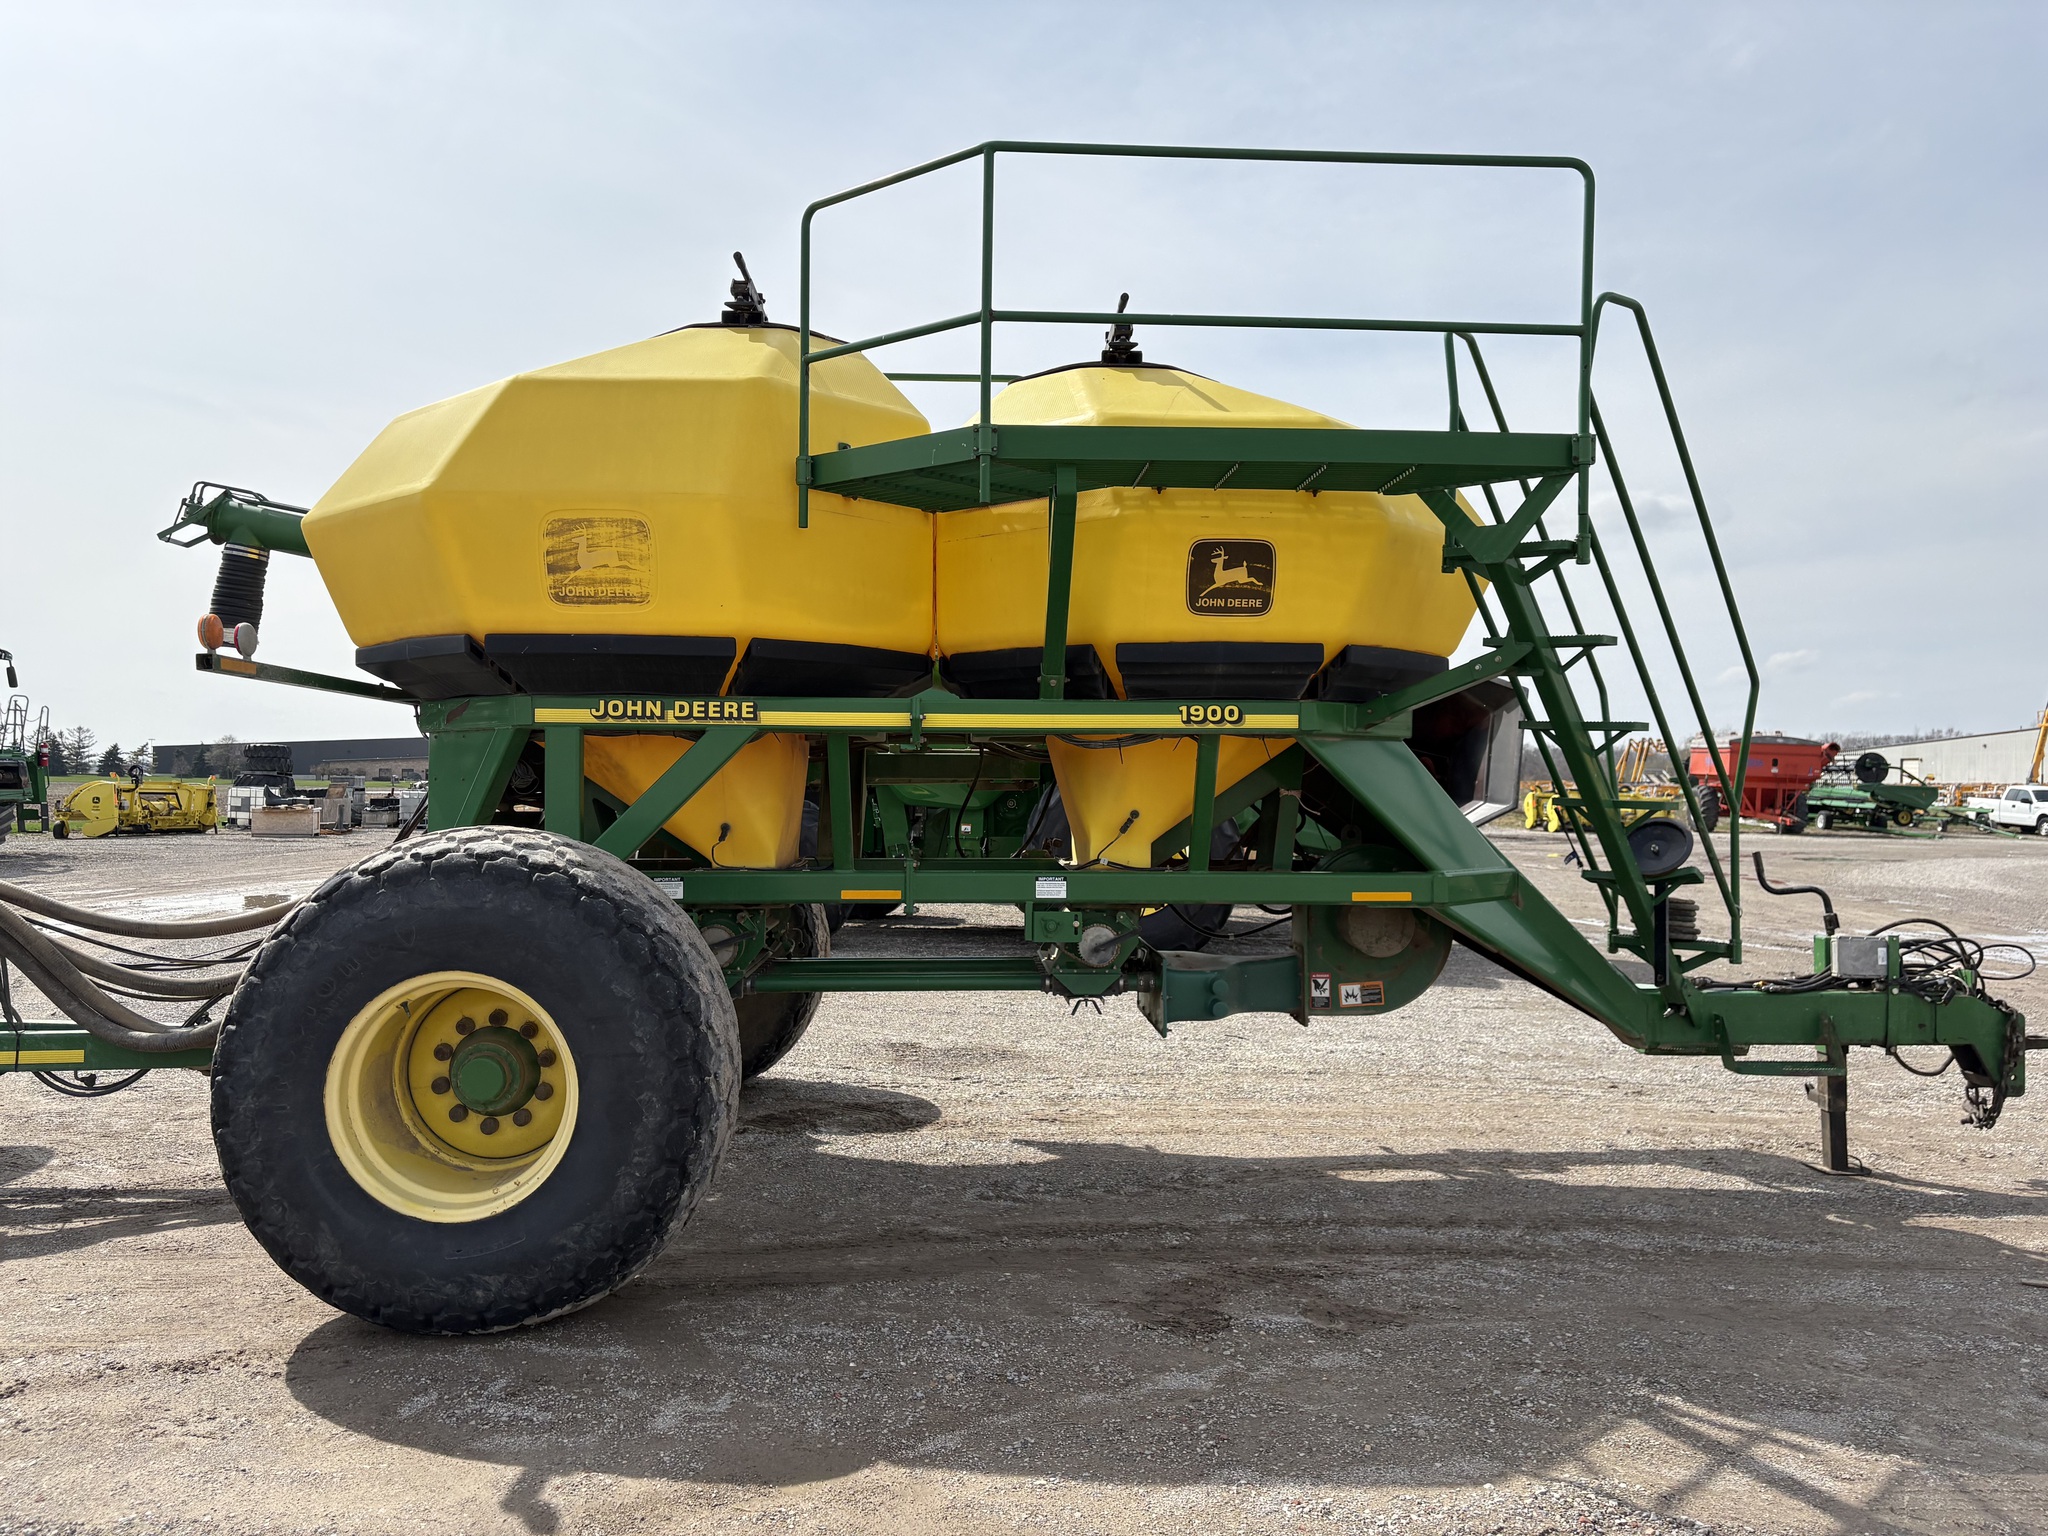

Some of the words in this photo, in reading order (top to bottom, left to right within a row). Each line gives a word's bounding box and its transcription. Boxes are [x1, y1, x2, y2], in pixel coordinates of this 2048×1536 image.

[558, 586, 596, 597] JOHN
[1195, 598, 1225, 607] JOHN
[1227, 598, 1263, 608] DEERE
[590, 699, 664, 719] JOHN
[674, 700, 757, 720] DEERE
[1178, 704, 1243, 724] 1900
